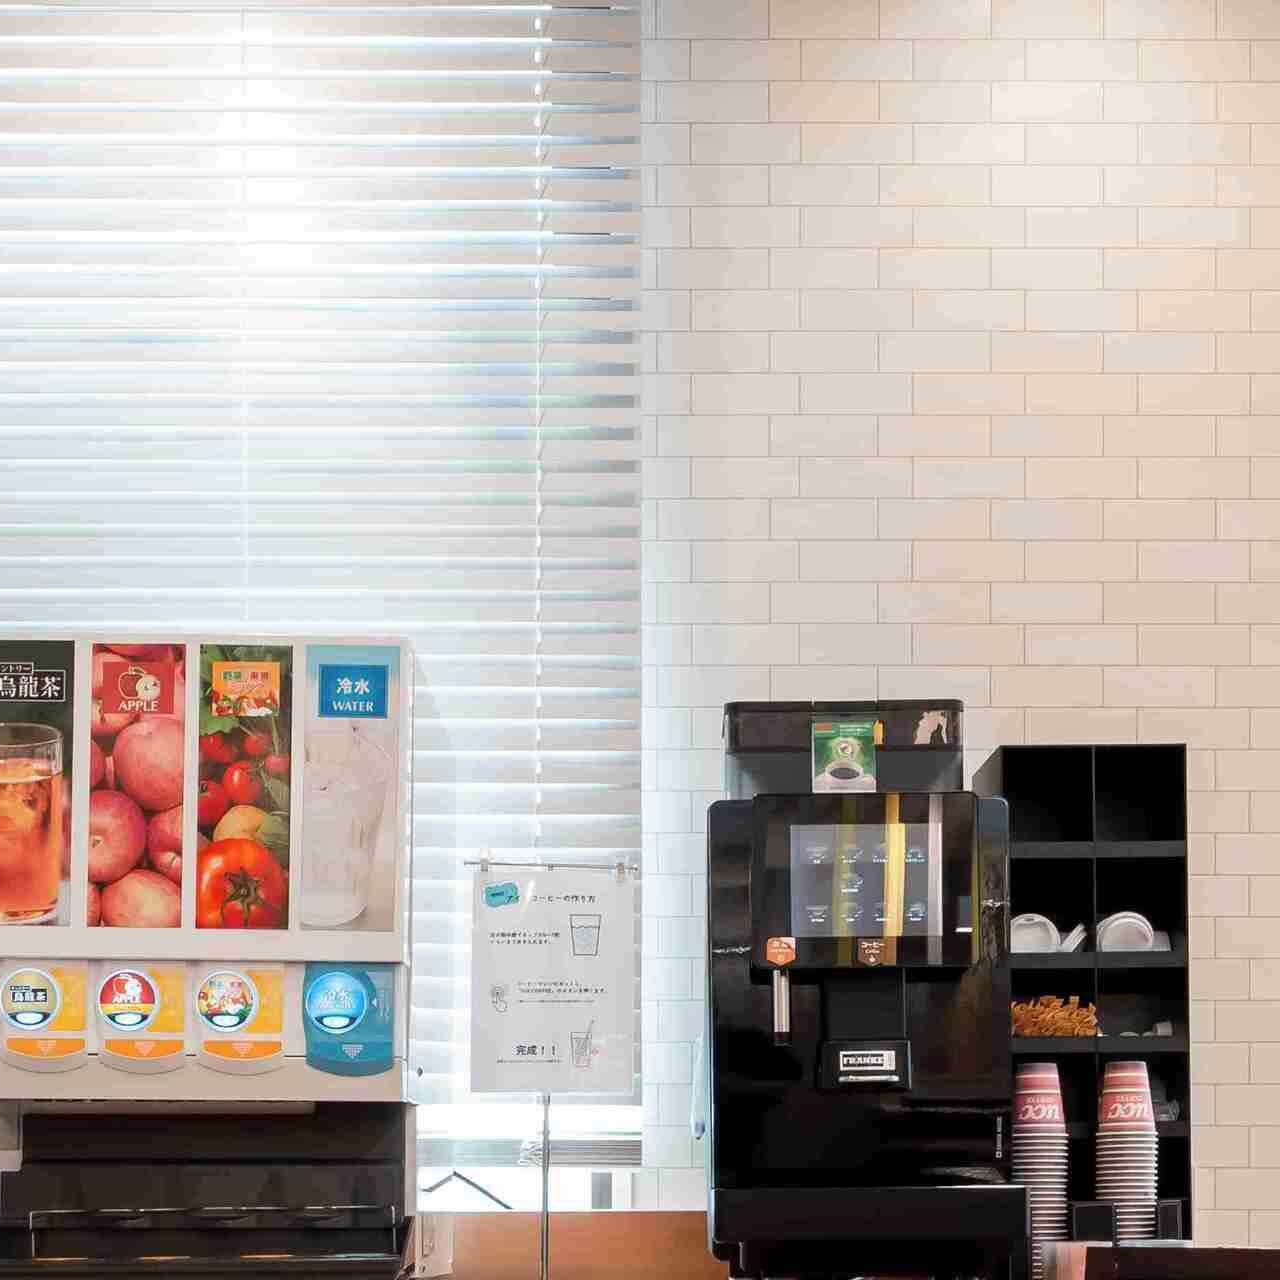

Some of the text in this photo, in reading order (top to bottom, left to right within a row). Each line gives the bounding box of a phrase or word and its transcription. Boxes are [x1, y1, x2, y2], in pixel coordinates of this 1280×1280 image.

[336, 677, 370, 695] 冷水
[118, 700, 159, 712] APPLE
[332, 700, 374, 712] WATER
[505, 895, 597, 904] アイコーヒーの作り方
